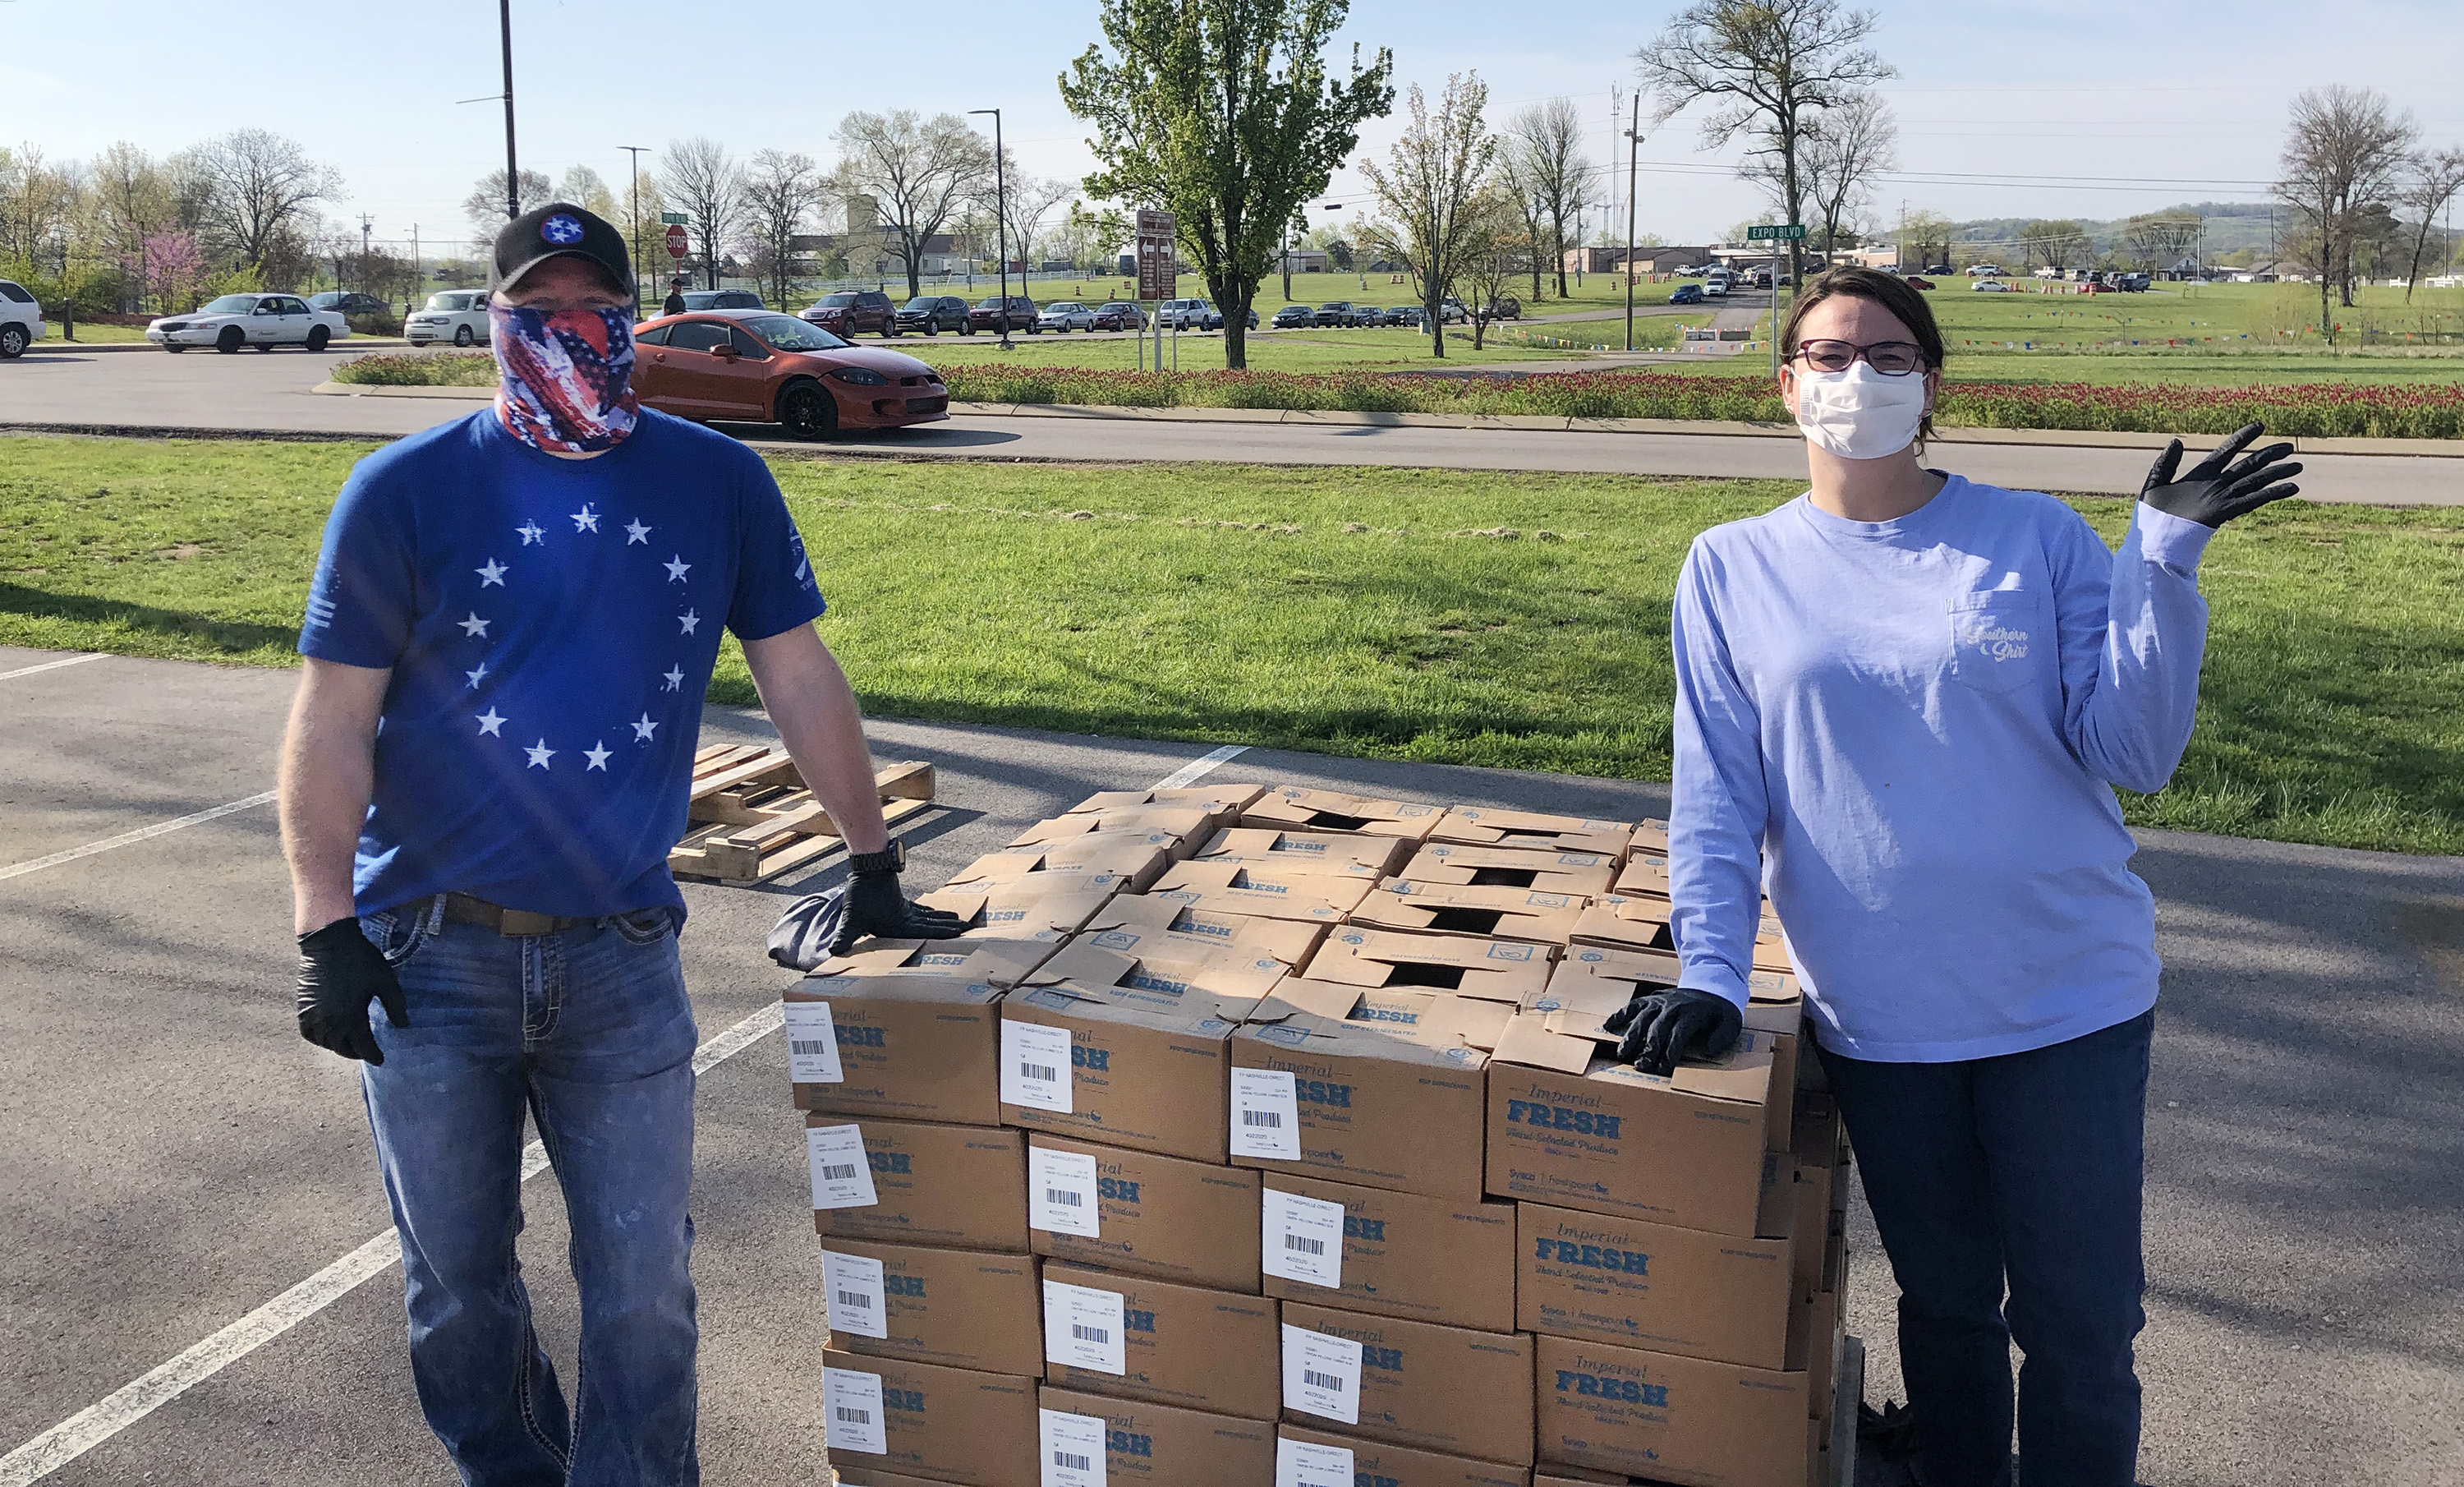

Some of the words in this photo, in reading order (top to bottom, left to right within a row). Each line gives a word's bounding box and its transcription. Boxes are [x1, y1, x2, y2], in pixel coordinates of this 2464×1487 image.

[667, 235, 687, 249] STOP
[1752, 228, 1774, 238] EXPO
[1778, 226, 1800, 237] BLVD
[1966, 624, 2029, 645] Southern
[1992, 641, 2029, 663] Shirt
[1365, 1001, 1410, 1011] Imperial
[1529, 1084, 1602, 1107] Imperial
[1507, 1099, 1621, 1139] FRESH
[1557, 1222, 1629, 1244] Imperial
[1536, 1236, 1649, 1276] FRESH
[1576, 1354, 1647, 1379] Imperial
[1556, 1369, 1669, 1408] FRESH
